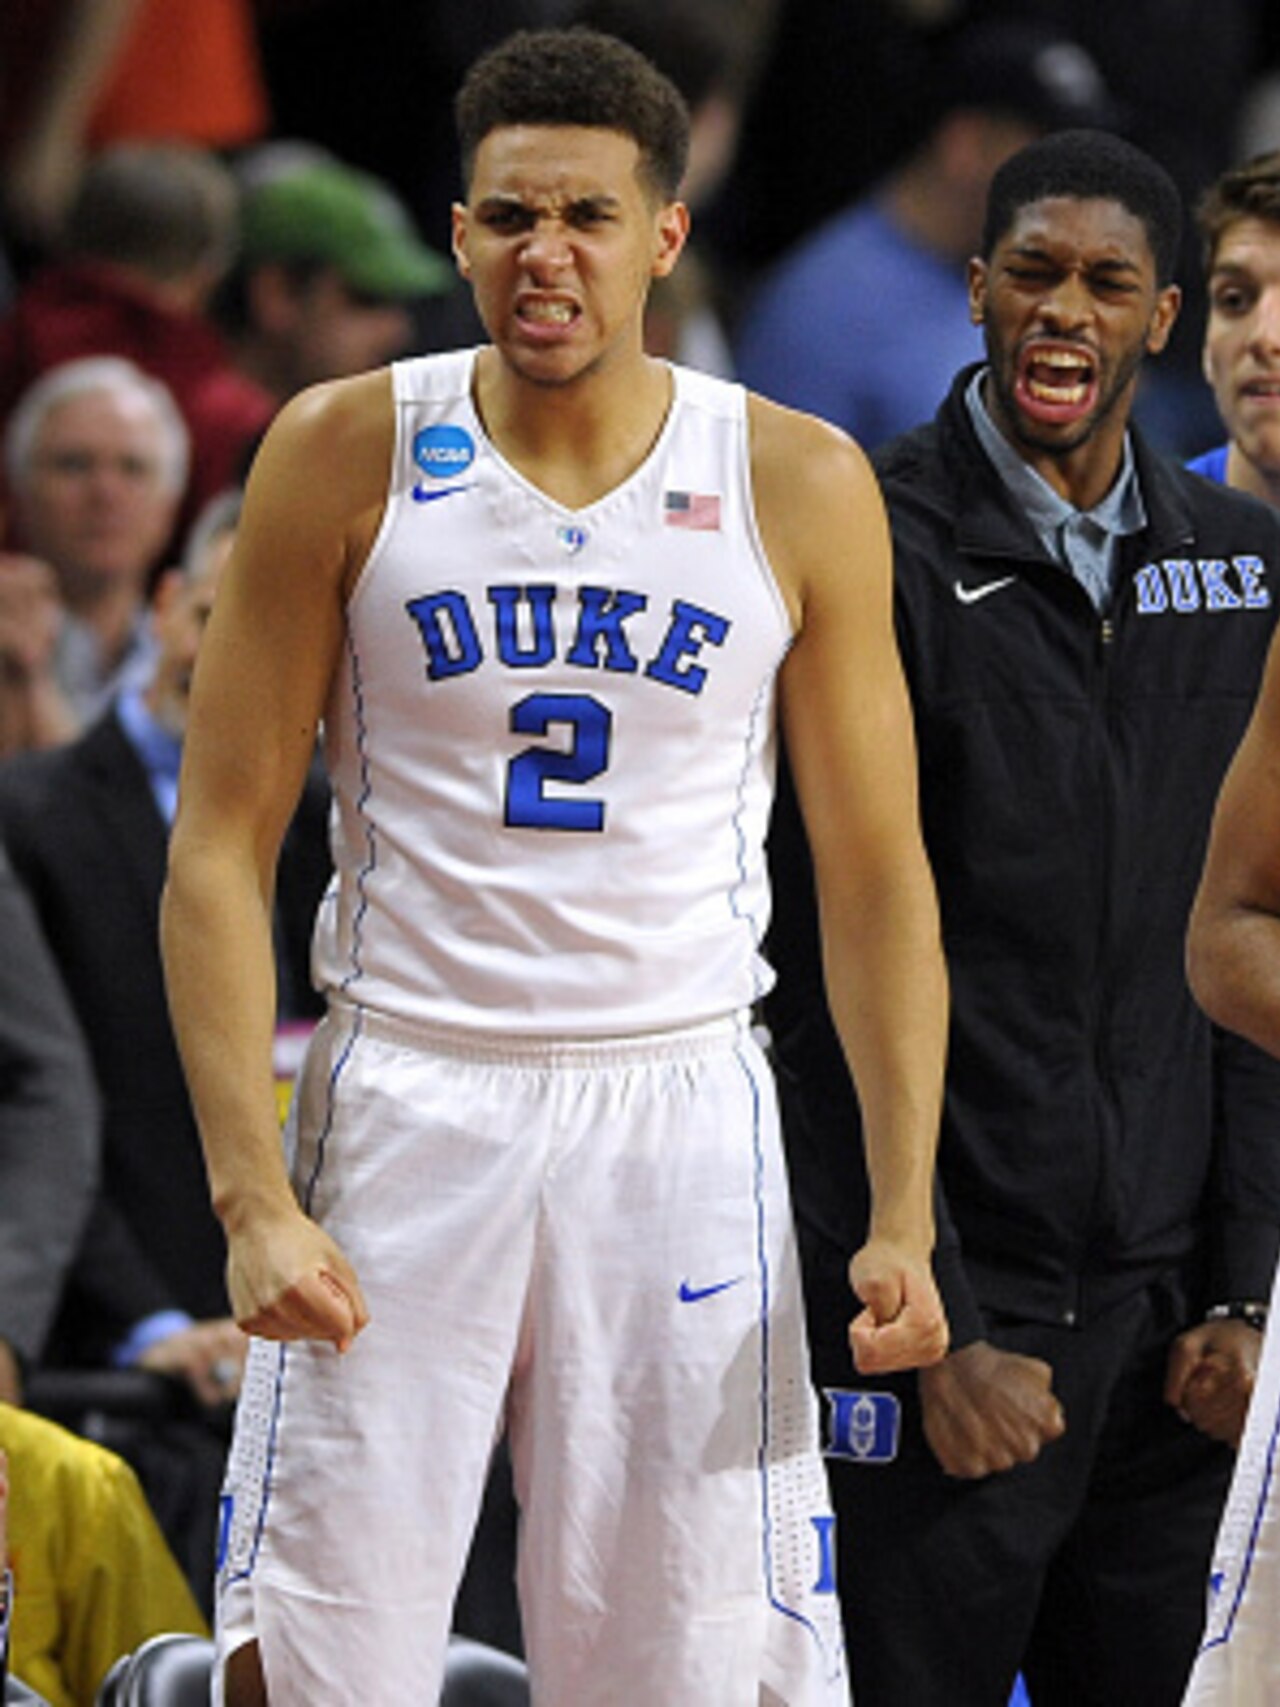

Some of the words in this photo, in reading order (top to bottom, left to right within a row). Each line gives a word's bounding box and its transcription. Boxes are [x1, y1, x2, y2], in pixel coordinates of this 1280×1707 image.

[420, 447, 470, 463] NCAA
[1133, 555, 1271, 614] DUKE
[404, 583, 733, 697] DUKE
[504, 691, 613, 832] 2
